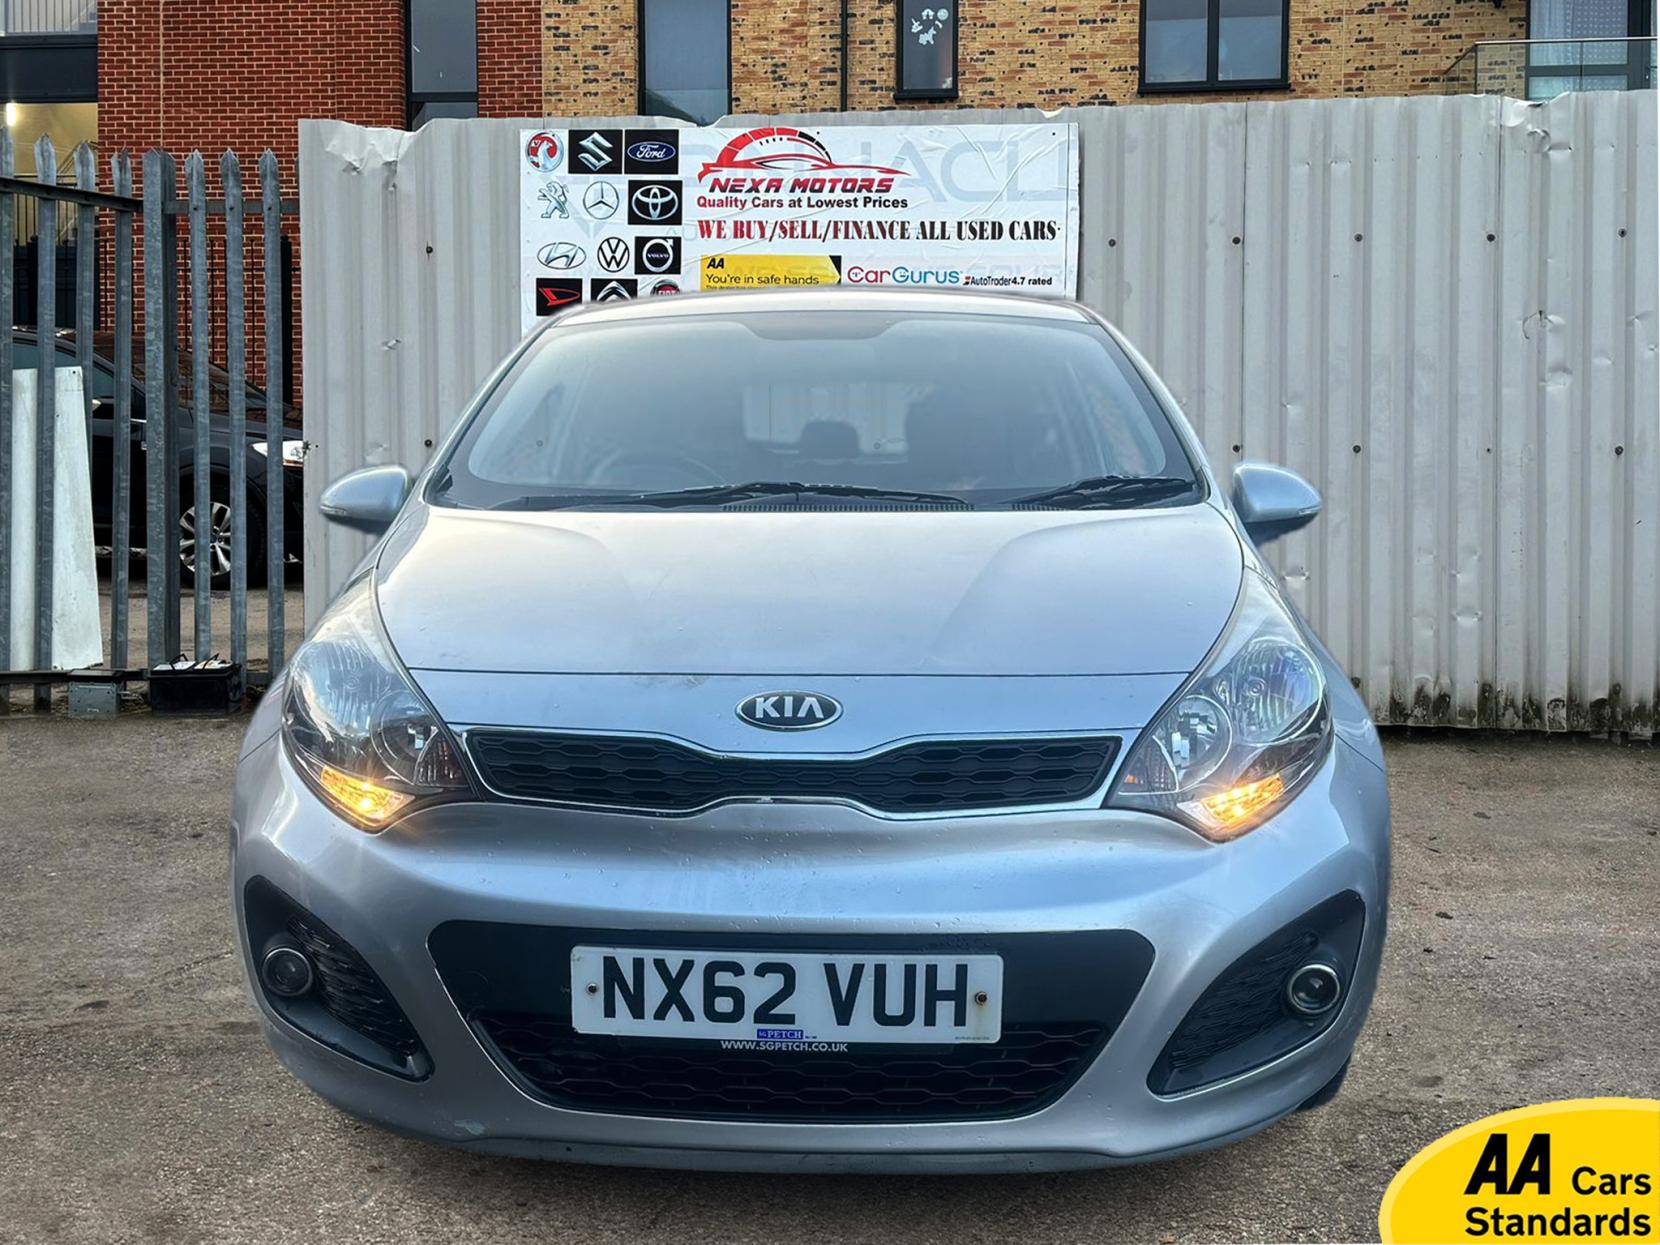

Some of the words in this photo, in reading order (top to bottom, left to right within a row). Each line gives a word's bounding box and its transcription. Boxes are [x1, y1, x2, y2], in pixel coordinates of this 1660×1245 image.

[636, 144, 666, 159] Ford
[708, 178, 784, 194] NEXA
[789, 178, 895, 193] MOTORS
[697, 196, 747, 210] Quality
[752, 196, 784, 208] Cars
[788, 197, 803, 208] at
[807, 196, 859, 208] Lowest
[863, 197, 908, 208] Prices
[697, 219, 727, 240] WE
[916, 220, 951, 240] ALL
[957, 220, 1004, 240] USED
[1008, 220, 1057, 240] CARS
[706, 257, 725, 269] AA
[706, 273, 741, 284] You're
[744, 274, 754, 284] in
[757, 274, 781, 284] safe
[784, 275, 820, 285] hands
[847, 266, 961, 284] CarGurus
[1028, 277, 1053, 285] rated
[755, 695, 824, 719] KIA
[602, 955, 797, 1025] NX62
[823, 962, 969, 1027] VUH
[767, 1030, 802, 1039] PETCH
[720, 1039, 848, 1053] WWW.SGPETCH.CO.UK
